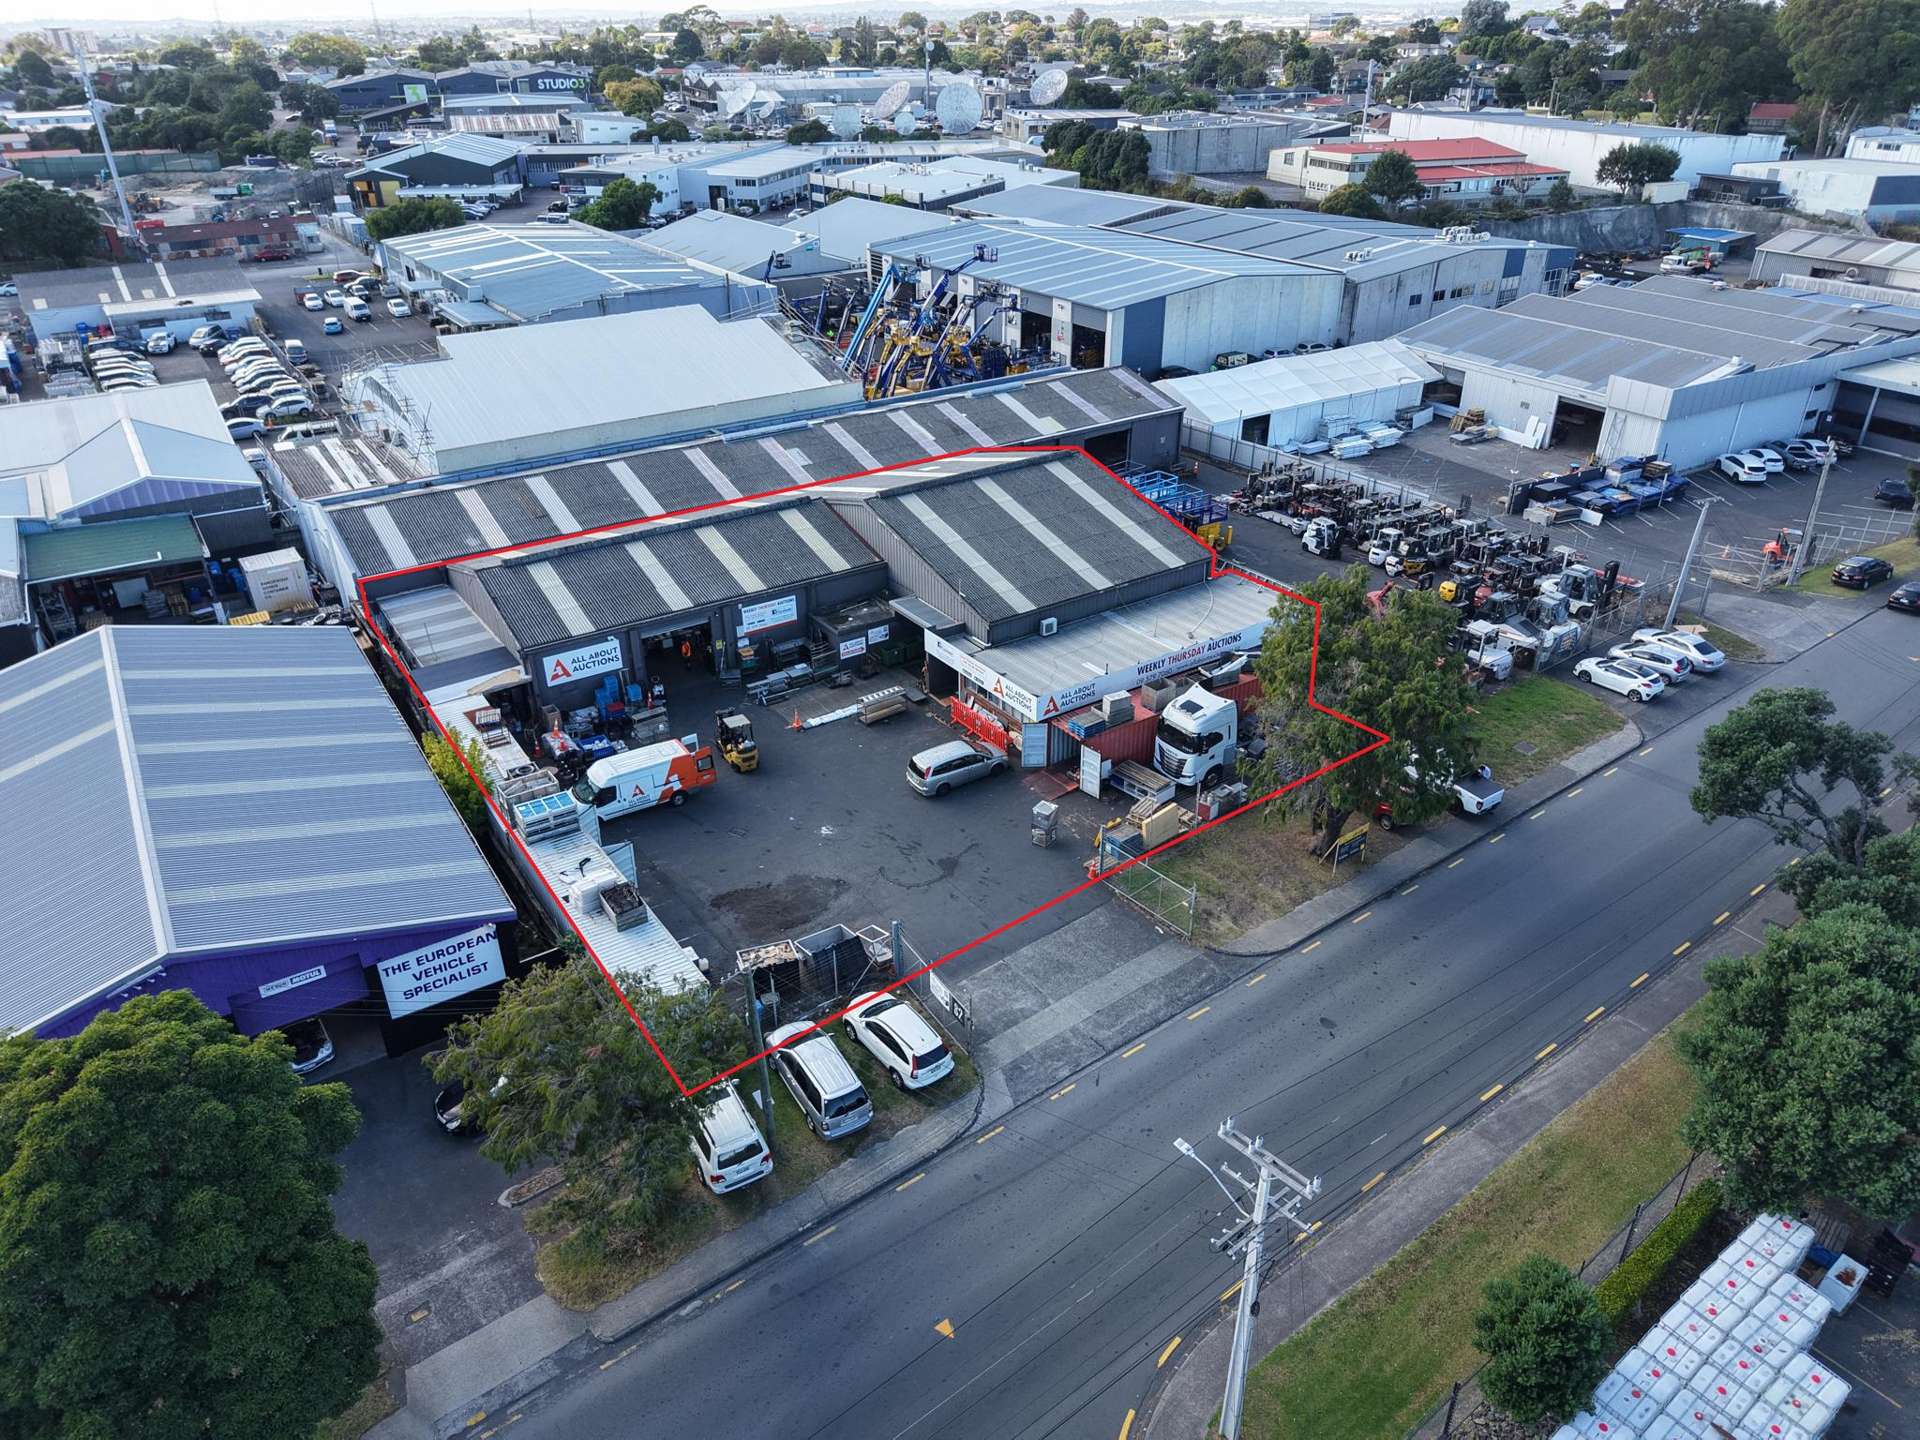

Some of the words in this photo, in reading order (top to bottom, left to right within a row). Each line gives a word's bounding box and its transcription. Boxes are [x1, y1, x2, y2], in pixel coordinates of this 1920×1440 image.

[538, 78, 585, 89] STUDIO3
[571, 655, 587, 664] ALL
[589, 646, 618, 660] ABOUT
[1137, 659, 1166, 675] WEEKLY
[1168, 645, 1206, 665] THURSDAY
[1207, 632, 1242, 652] AUCTIONS
[572, 654, 620, 673] AUCTIONS
[1060, 689, 1096, 708] AUCTIONS
[1061, 692, 1074, 700] ALL
[1074, 682, 1096, 697] ABOUT
[1005, 691, 1032, 712] AUCTIONS
[382, 960, 411, 978] THE
[416, 931, 497, 967] EUROPEAN
[412, 952, 475, 982] VEHICLE
[292, 970, 320, 984] MOTUL
[403, 961, 489, 1000] SPECIALIST
[953, 1002, 963, 1020] 67
